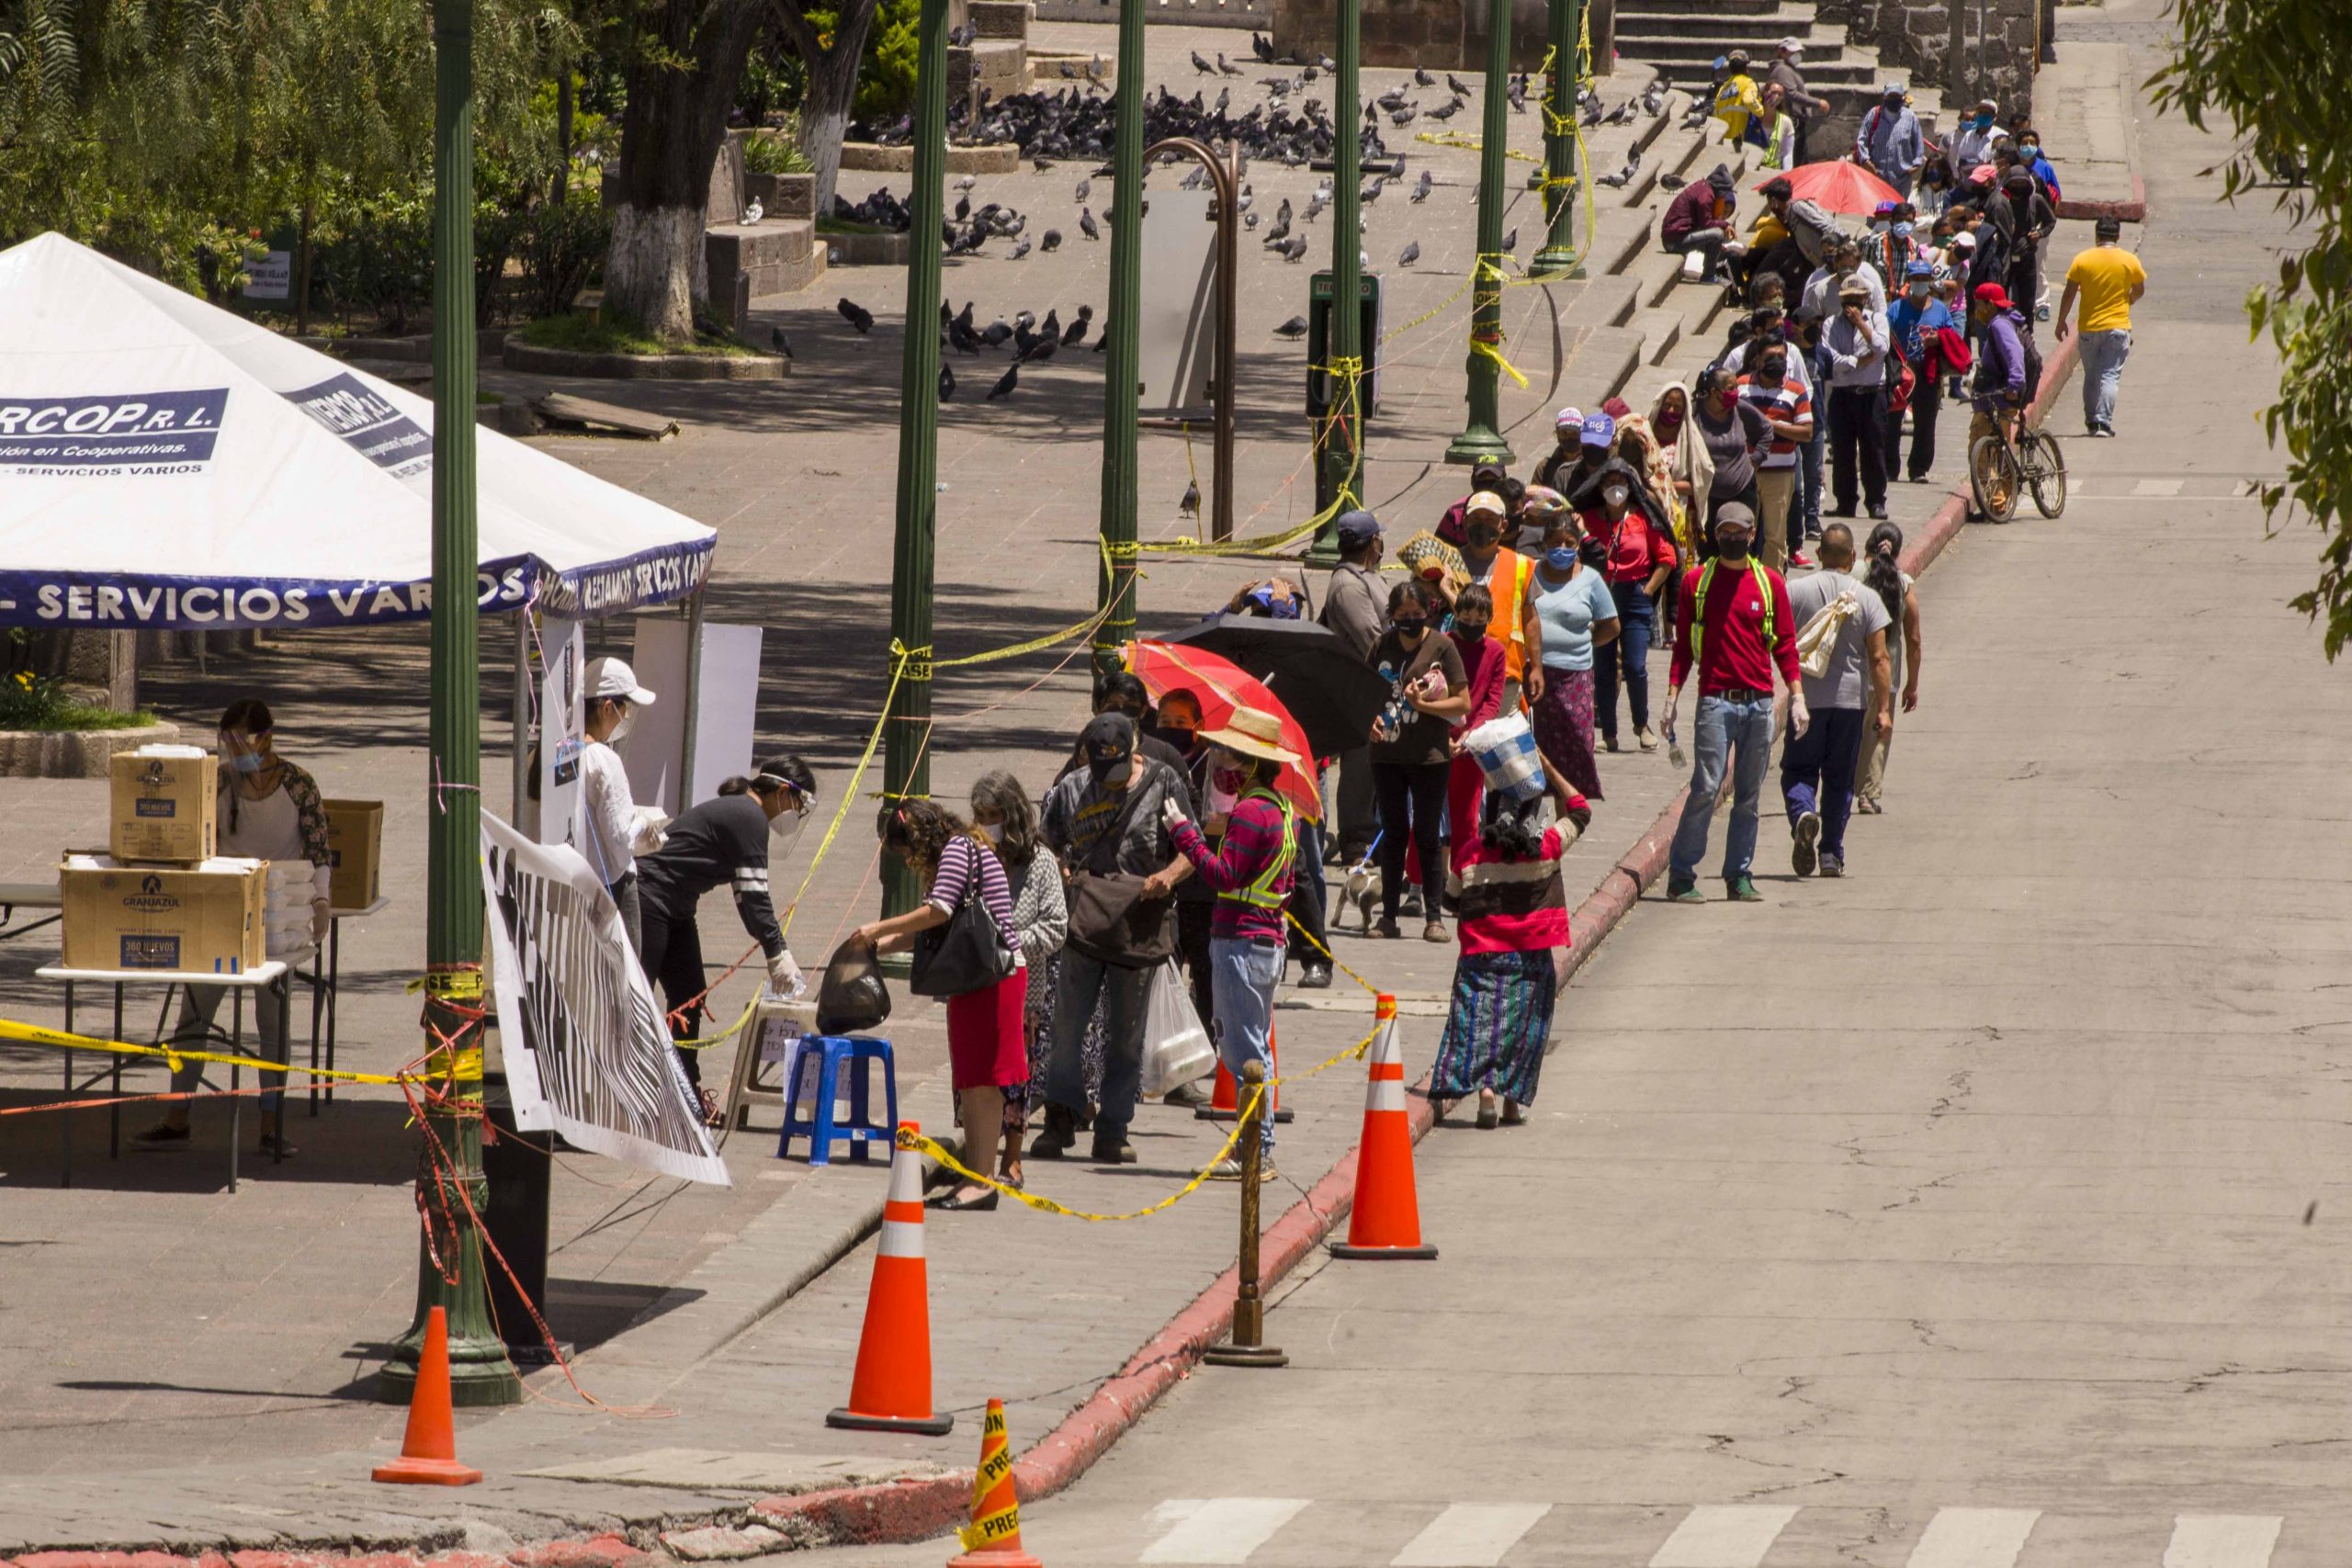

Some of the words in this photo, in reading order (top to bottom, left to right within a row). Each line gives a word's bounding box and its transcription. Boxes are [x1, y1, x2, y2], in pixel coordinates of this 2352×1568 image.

[1589, 420, 1605, 433] tigo
[0, 446, 30, 456] ión
[33, 447, 59, 456] en
[62, 444, 187, 458] Cooperativas.
[17, 467, 121, 476] SERVICIOS
[130, 464, 202, 476] VARIOS
[37, 584, 310, 622] SERVICIOS
[328, 567, 526, 617] VAROS
[122, 897, 180, 908] GRANJAZUL
[143, 942, 175, 952] HUEVOS
